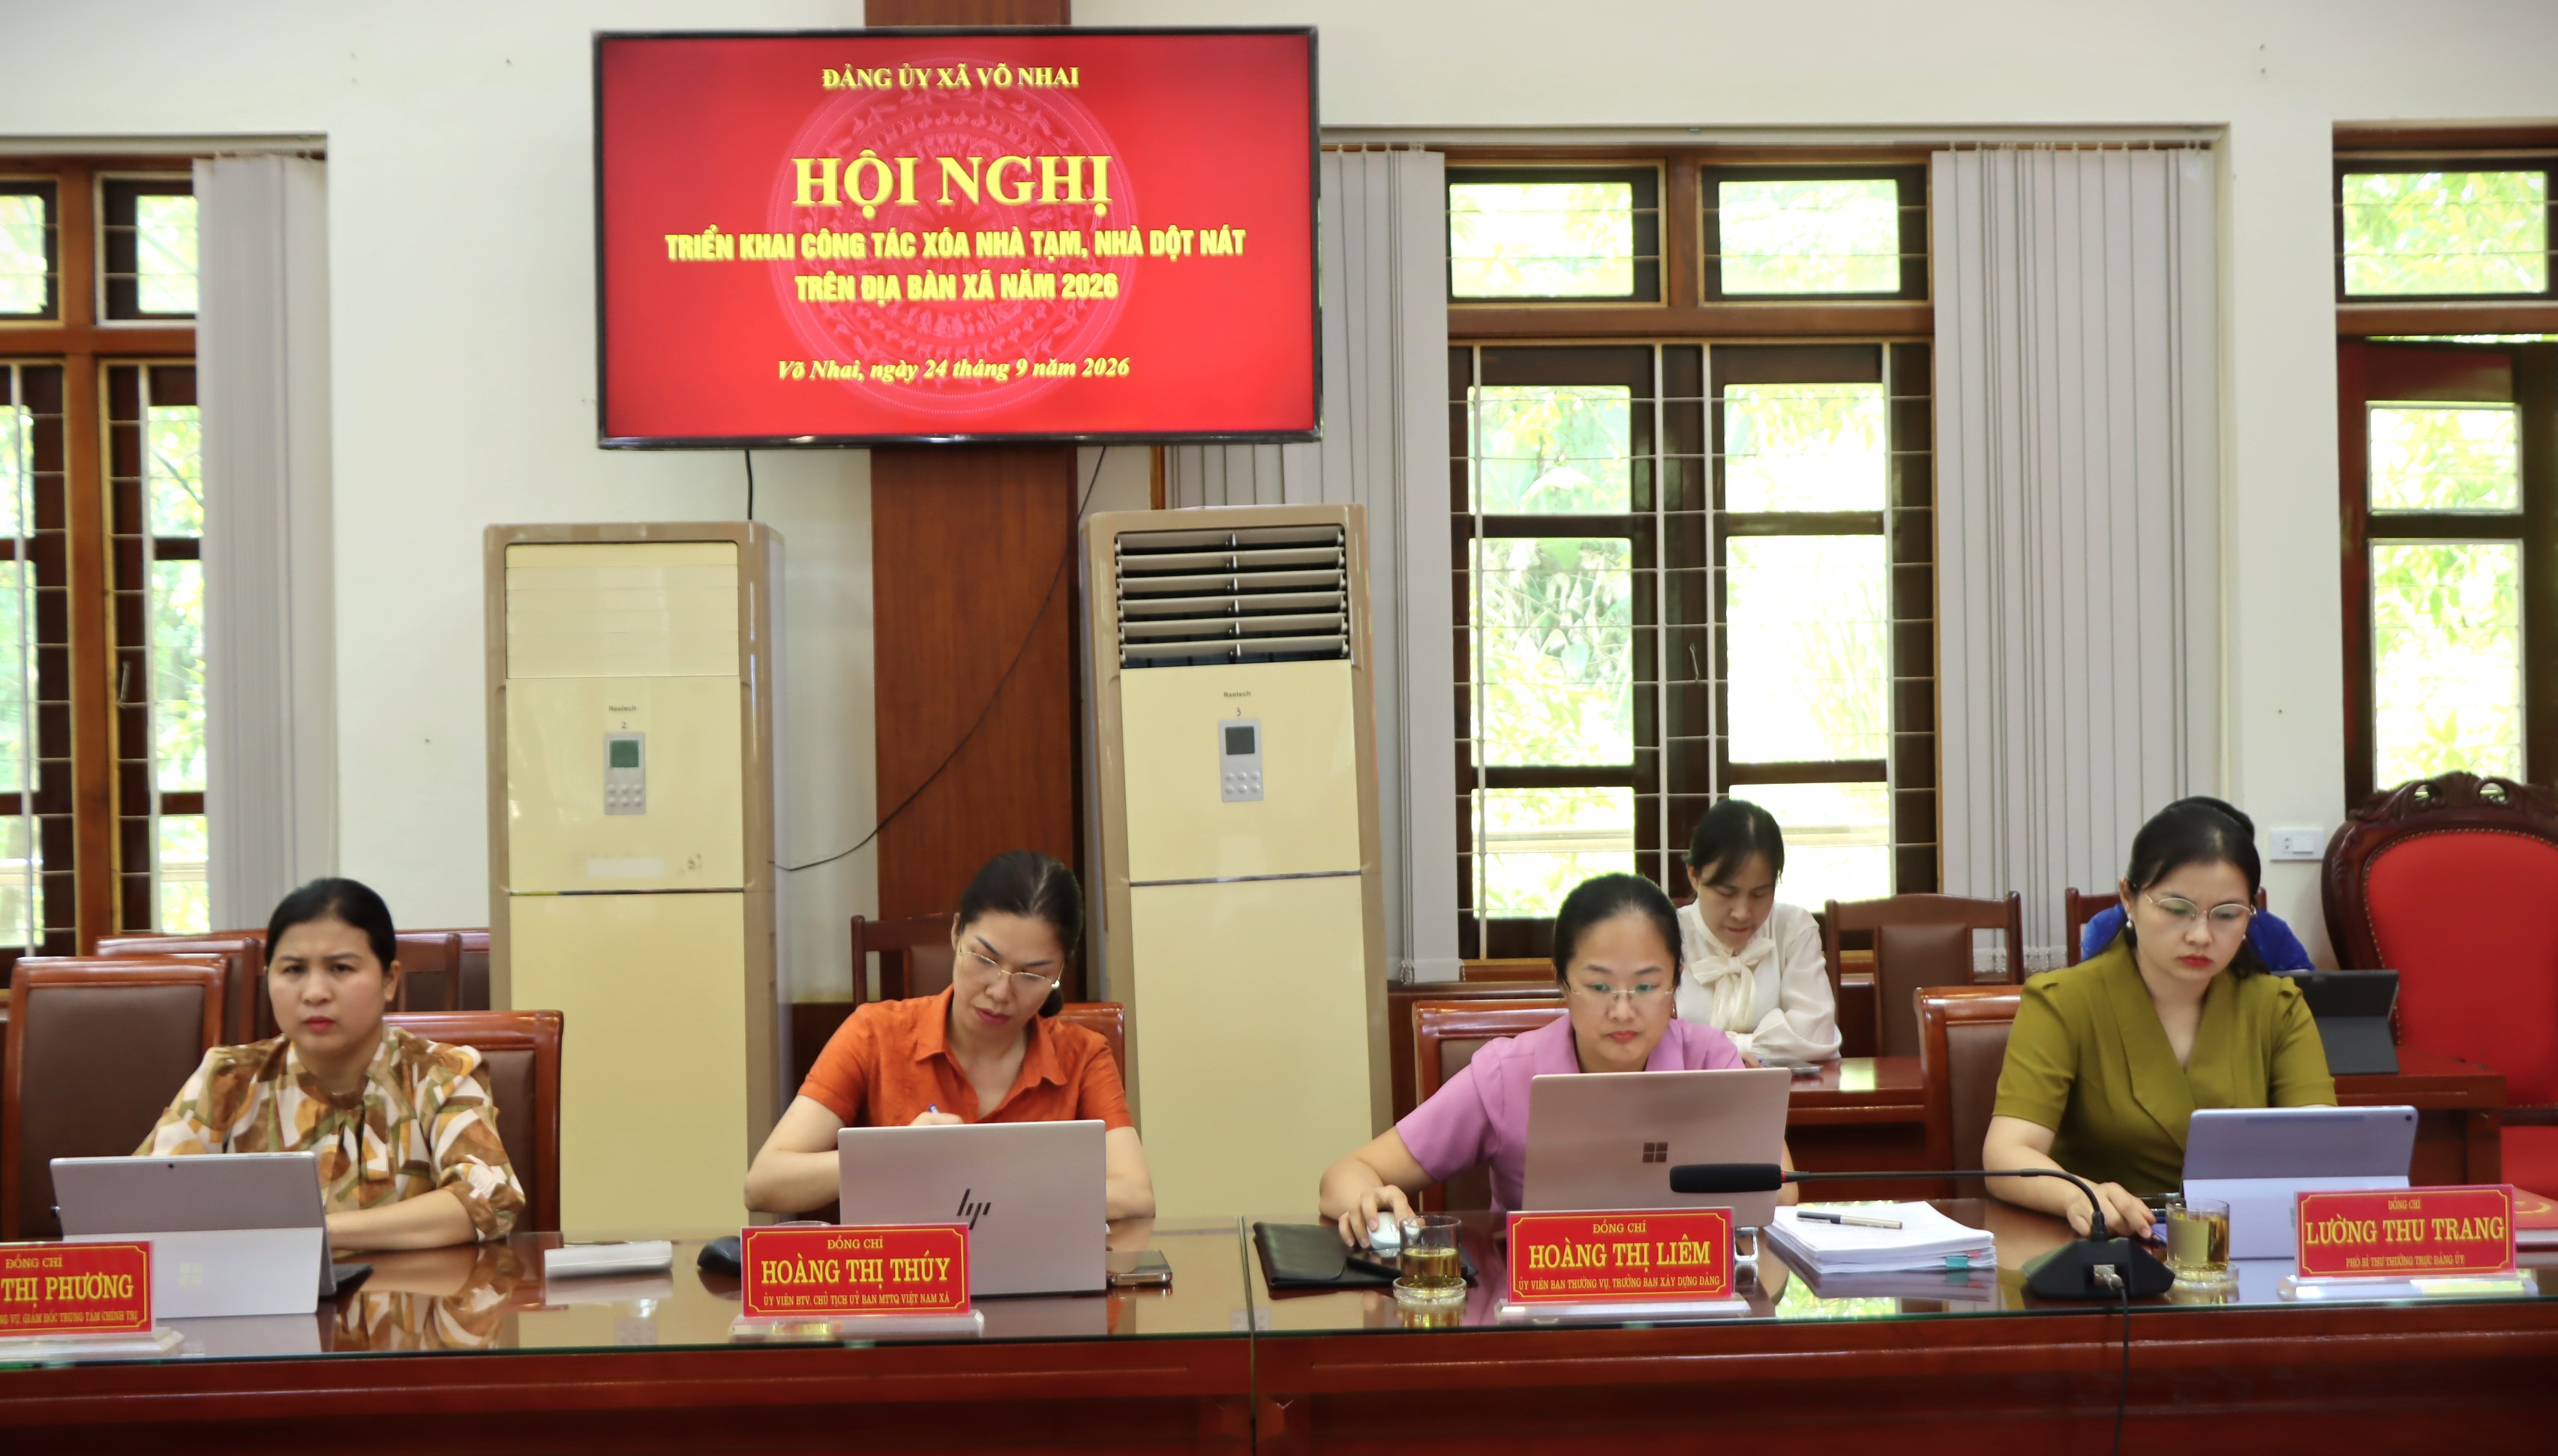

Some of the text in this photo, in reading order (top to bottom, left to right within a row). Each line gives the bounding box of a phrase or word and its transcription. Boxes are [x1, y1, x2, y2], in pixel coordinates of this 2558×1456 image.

[822, 63, 1079, 89] ĐẢNG ỦY XÃ VÕ NHAI
[791, 149, 1112, 219] HỘI NGHỊ
[665, 224, 1247, 262] TRIỂN KHAI CÔNG TÁC XÓA NHÀ TẠM, NHÀ DỘT NÁT
[794, 269, 1118, 308] TRÊN ĐỊA BÀN XÃ NĂM 2026
[779, 357, 1130, 384] Võ Nhai, ngày 24 tháng 9 năm 2026
[956, 1188, 992, 1230] hp
[2388, 1196, 2421, 1210] ĐỒNG CHÍ
[1593, 1219, 1647, 1233] ĐỒNG CHÍ
[2305, 1213, 2505, 1244] LƯỜNG THU TRANG
[827, 1235, 883, 1249] ĐỒNG CHÍ
[1529, 1234, 1710, 1272] HOÀNG THỊ LIÊM
[5, 1253, 63, 1268] ĐỒNG CHÍ
[761, 1250, 950, 1289] HOÀNG THỊ THÚY
[1, 1271, 134, 1308] THỊ PHƯƠNG
[1531, 1277, 1548, 1289] VIÊN
[1551, 1279, 1566, 1289] BAN
[1567, 1275, 1597, 1288] THƯỜNG
[1612, 1273, 1641, 1287] TRƯỞNG
[1644, 1277, 1658, 1286] BAN
[1660, 1273, 1675, 1286] XÂY
[1677, 1275, 1697, 1288] DỰNG
[1699, 1271, 1720, 1285] ĐẢNG
[776, 1292, 794, 1305] VIÊN
[813, 1290, 828, 1305] CHỦ
[830, 1295, 848, 1307] TỊCH
[862, 1294, 877, 1304] BAN
[879, 1293, 899, 1304] MTTQ
[901, 1290, 918, 1305] VIỆT
[920, 1293, 937, 1303] NAM
